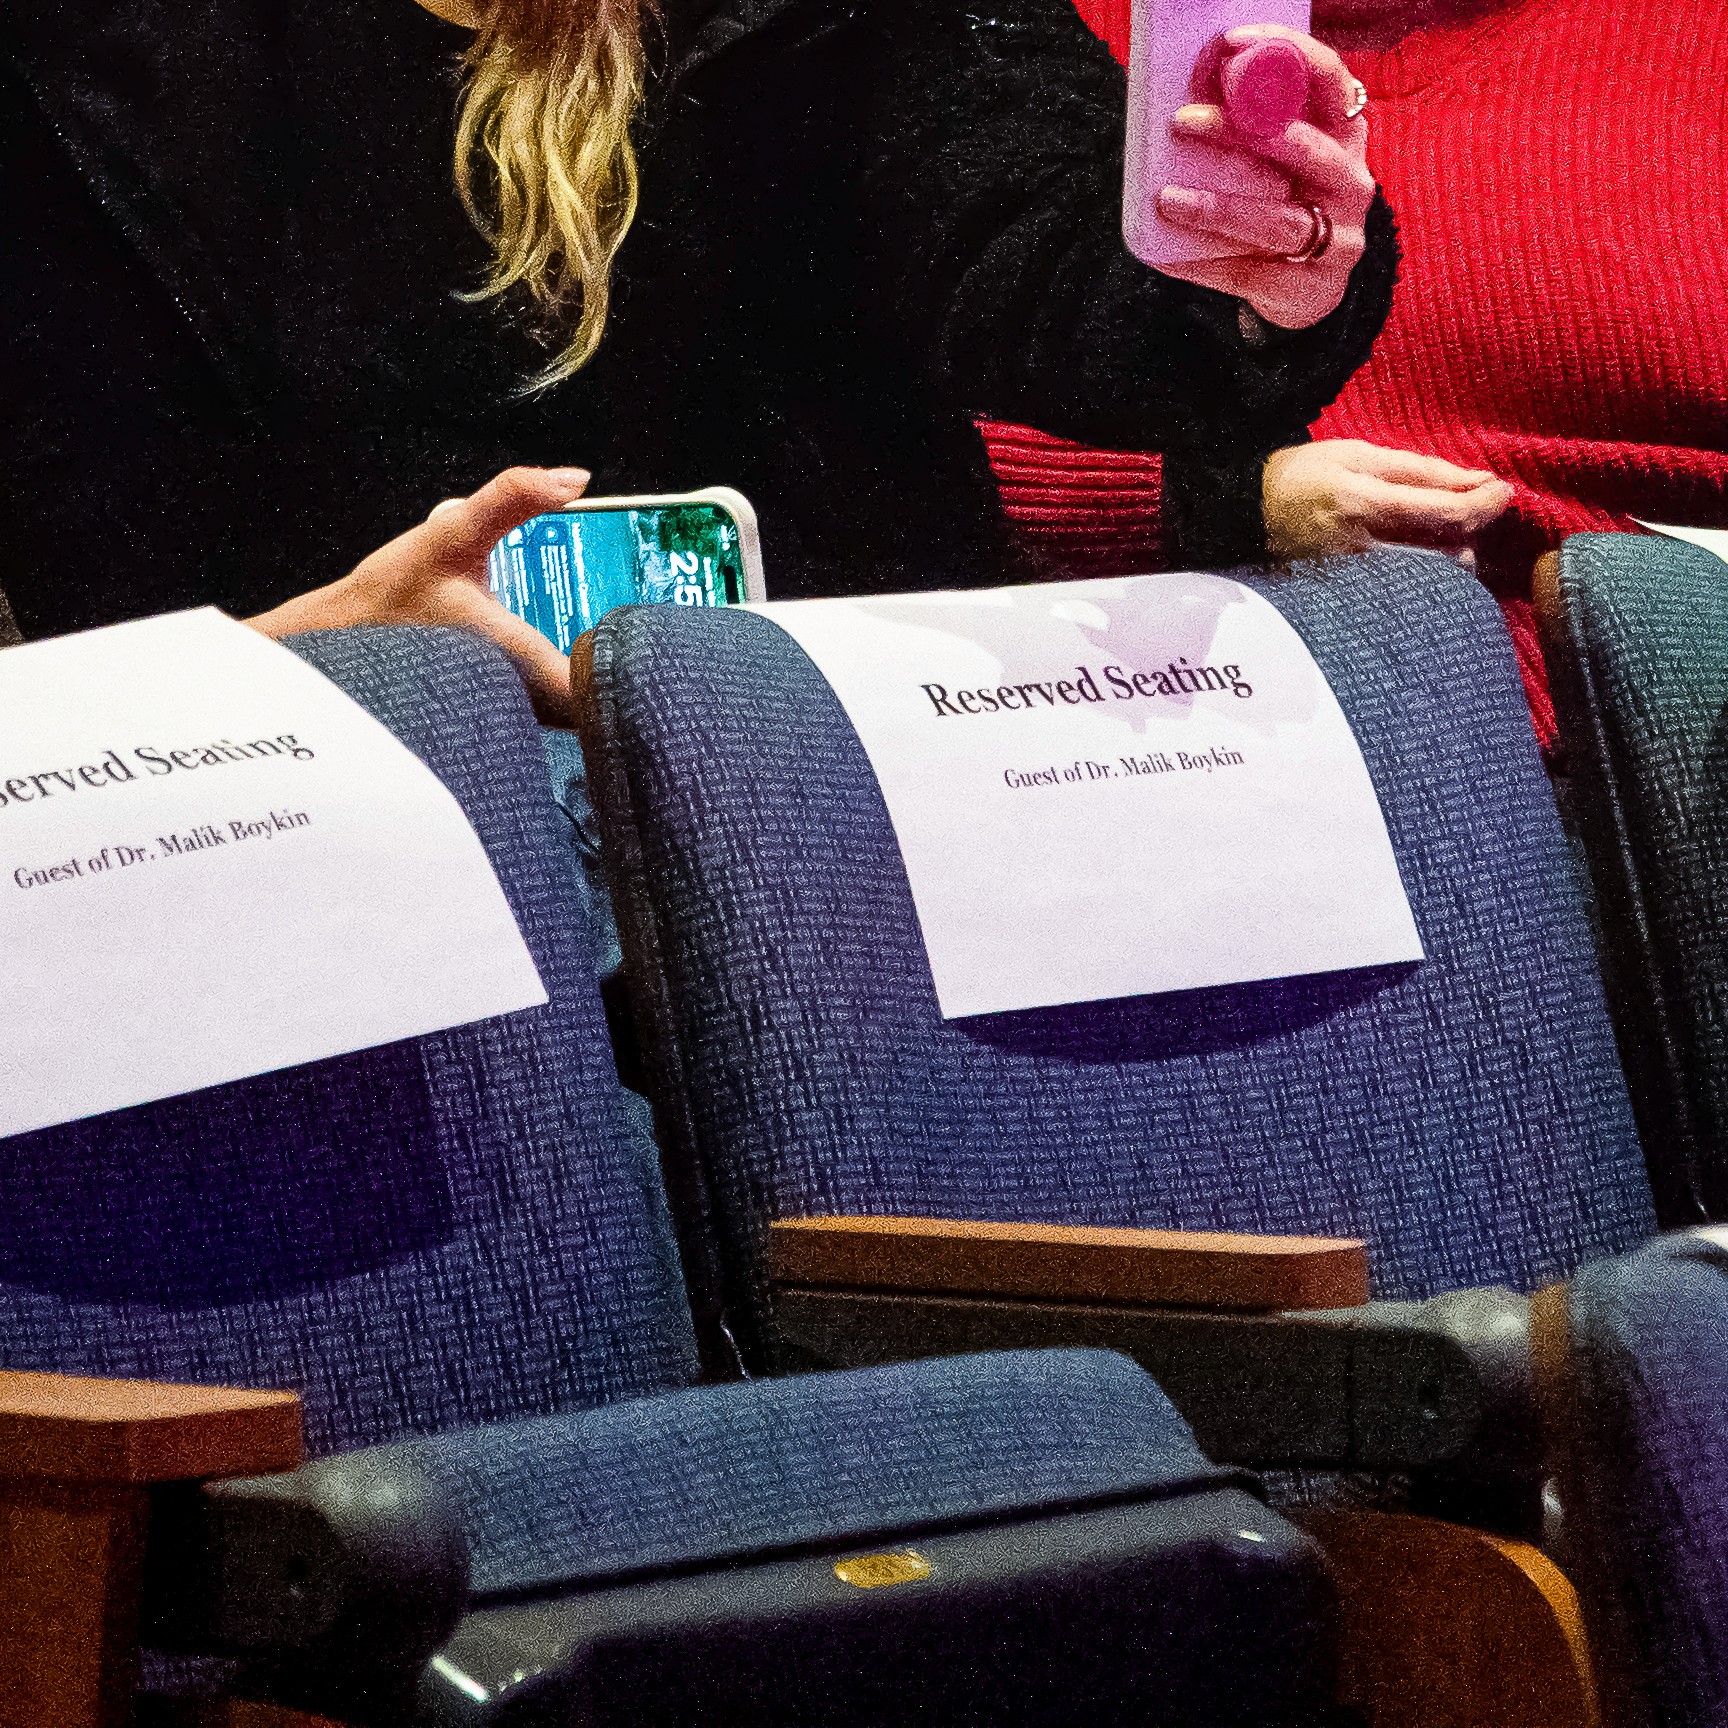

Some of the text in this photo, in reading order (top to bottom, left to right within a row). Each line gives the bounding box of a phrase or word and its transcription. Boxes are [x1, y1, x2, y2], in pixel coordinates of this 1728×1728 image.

[920, 657, 1254, 717] Reserved Seating
[136, 734, 315, 776] Seating
[1003, 747, 1245, 789] Guest of Dr. Malik Boykin
[13, 809, 311, 890] Guest of Dr. Malik Boykin
